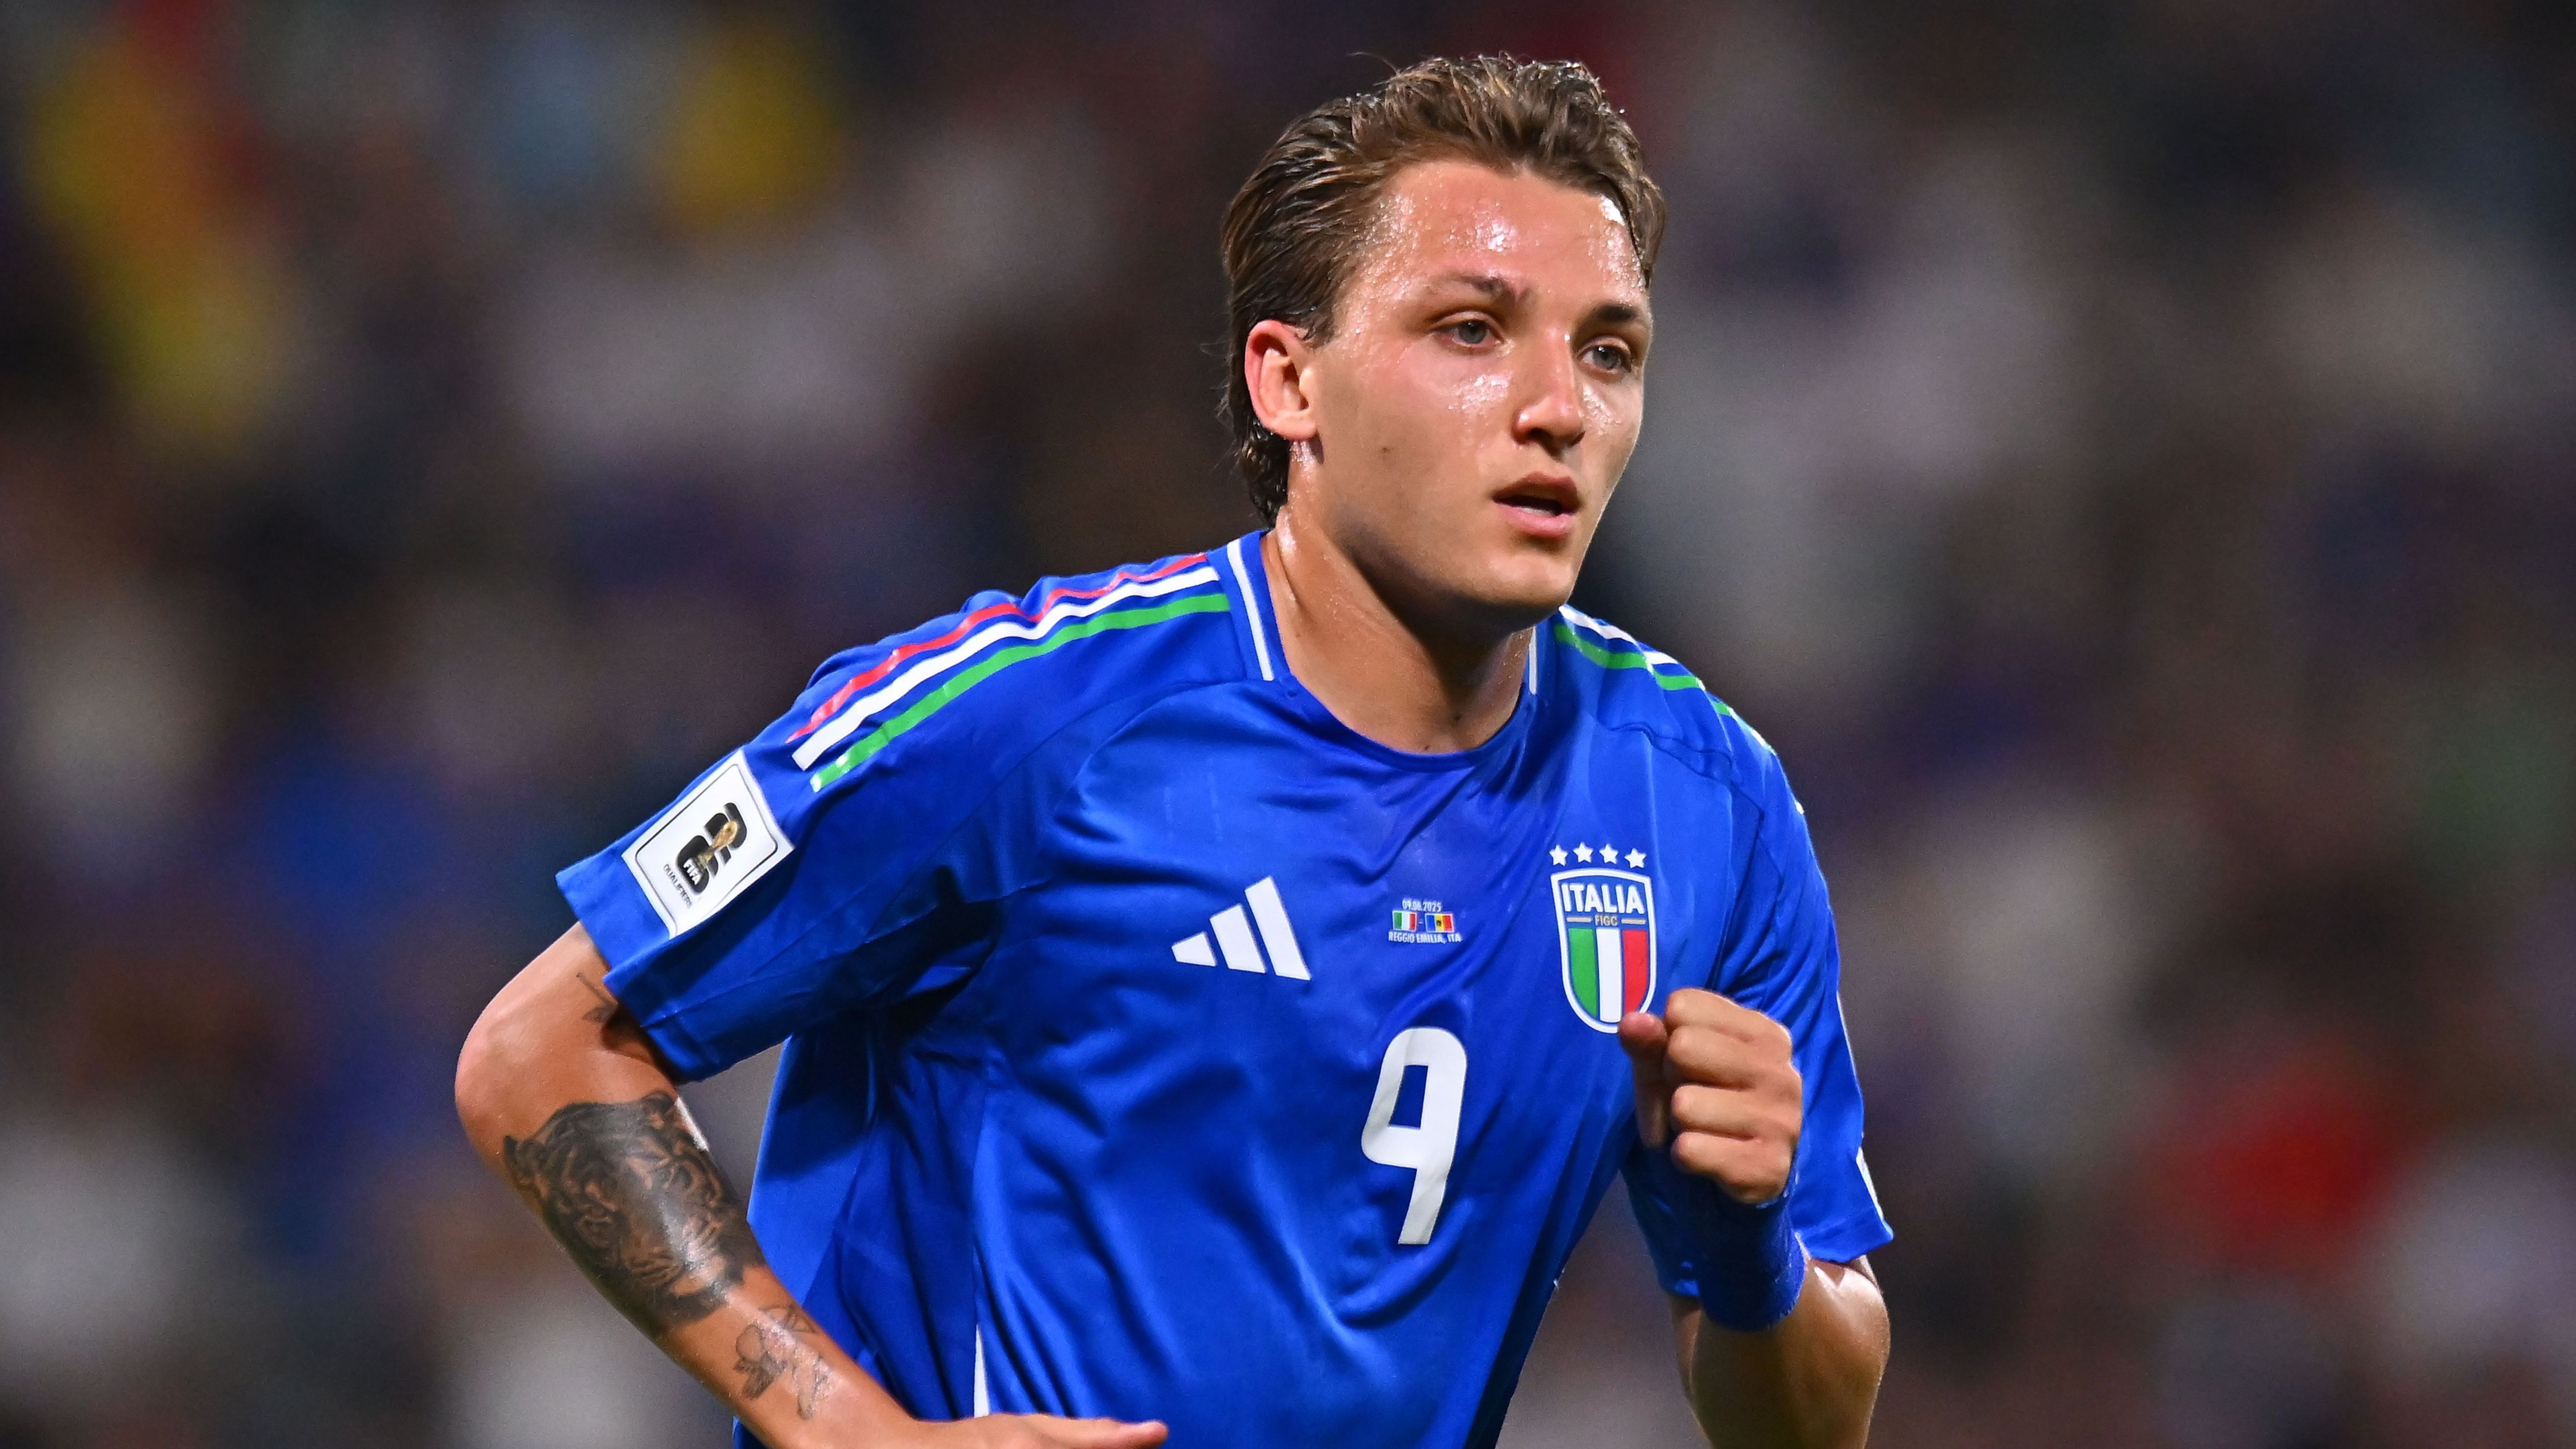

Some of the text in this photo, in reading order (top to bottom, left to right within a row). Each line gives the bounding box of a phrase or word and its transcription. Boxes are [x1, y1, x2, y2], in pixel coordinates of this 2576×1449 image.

[663, 864, 693, 908] QUALIFIERS
[683, 858, 702, 885] FIFA
[1561, 883, 1645, 914] ITALIA
[1594, 915, 1618, 927] FIGC
[1388, 931, 1463, 944] REGGIO EMILIA, ITA
[1361, 1027, 1467, 1245] 9
